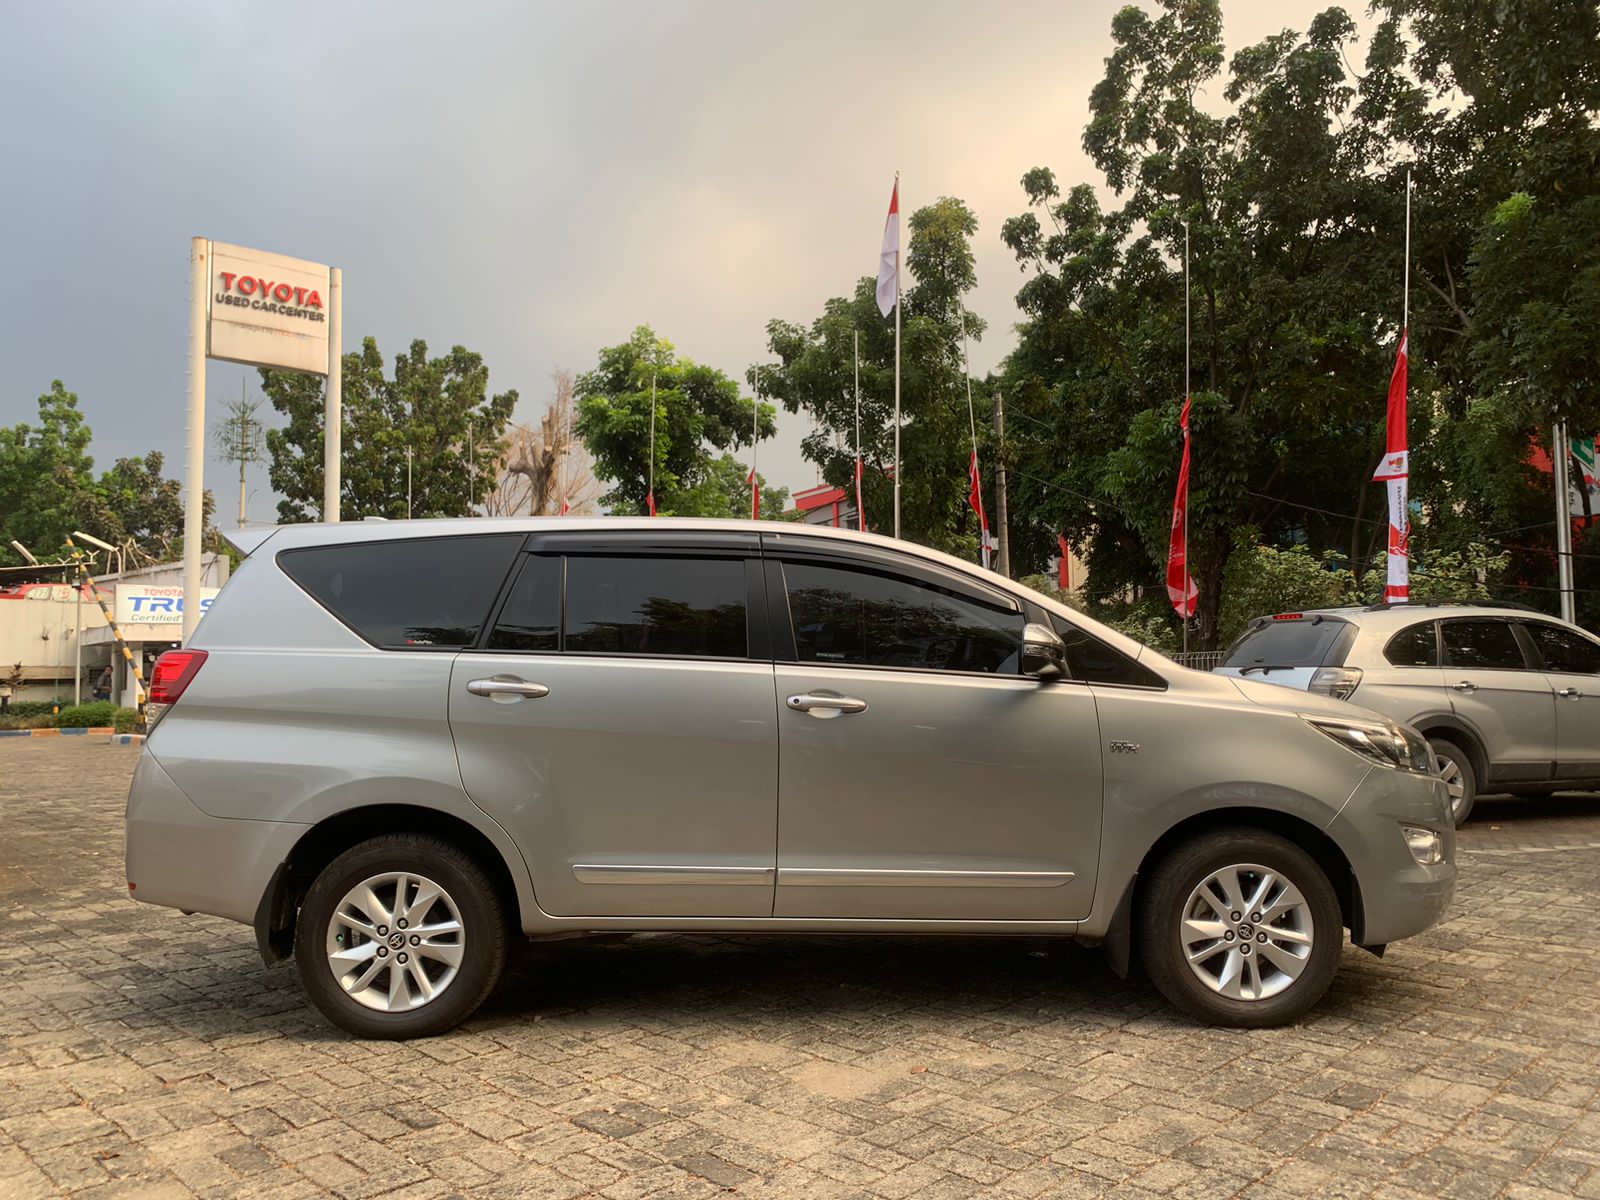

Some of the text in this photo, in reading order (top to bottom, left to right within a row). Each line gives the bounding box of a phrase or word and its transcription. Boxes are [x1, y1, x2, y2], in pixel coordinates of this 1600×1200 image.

[220, 271, 324, 309] TOYOTA
[215, 293, 325, 322] USED CAR CENTER
[144, 588, 184, 597] TOYOTA
[131, 614, 180, 622] Certified
